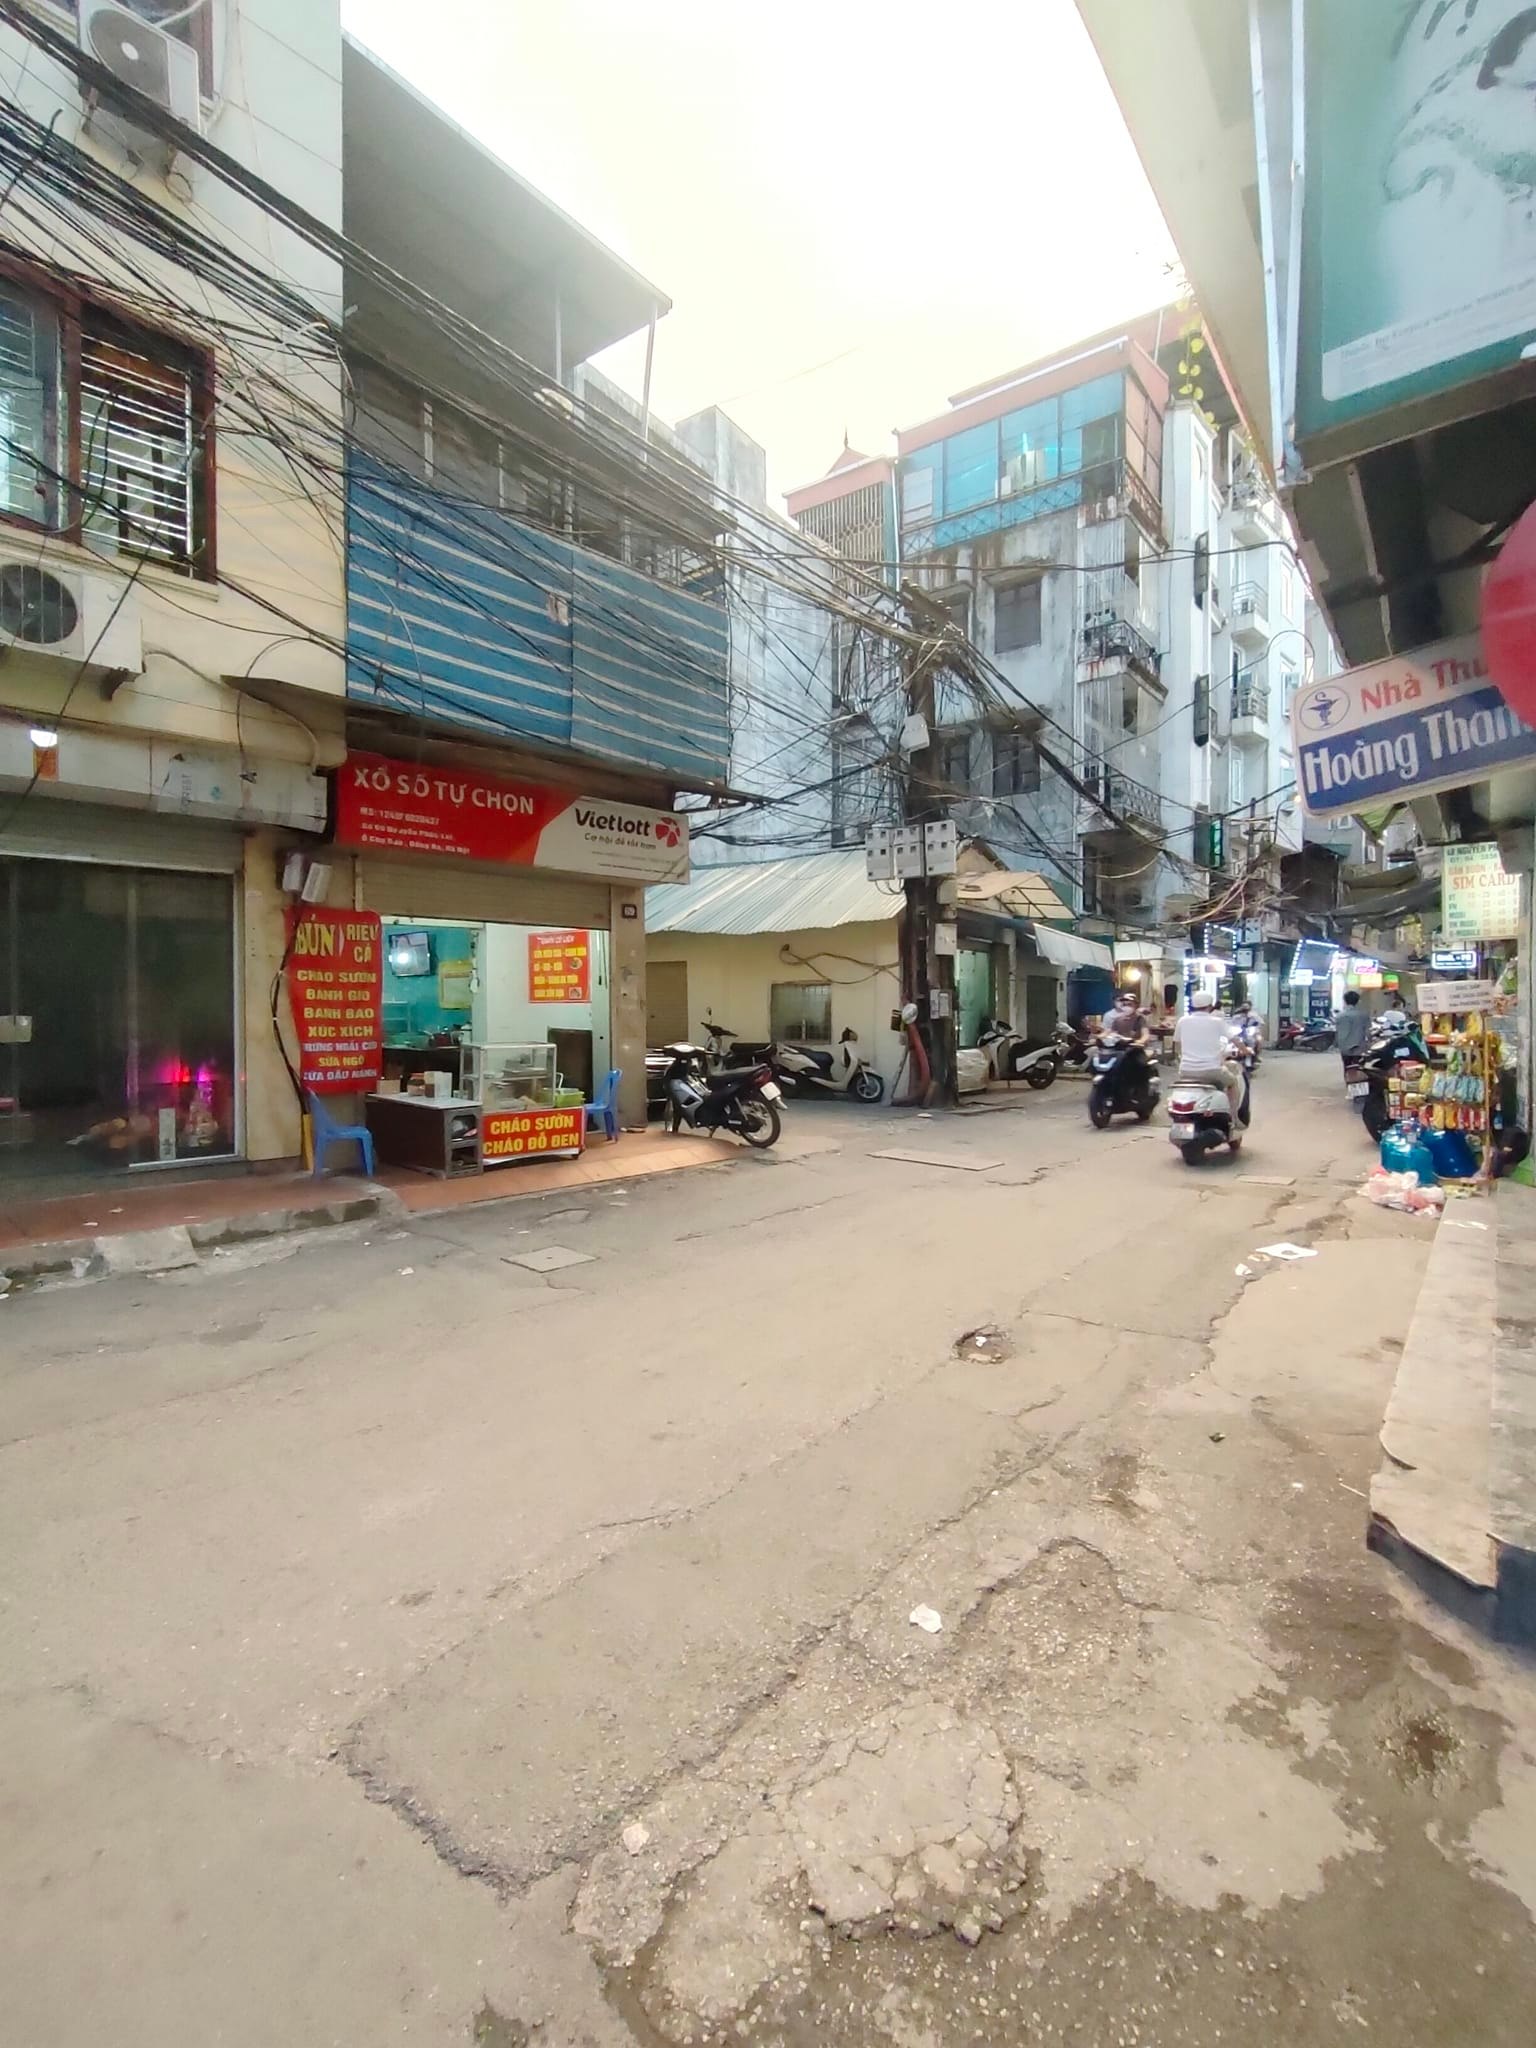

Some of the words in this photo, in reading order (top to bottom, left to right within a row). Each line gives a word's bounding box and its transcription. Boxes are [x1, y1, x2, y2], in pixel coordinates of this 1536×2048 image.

[1360, 672, 1422, 713] Nhà
[1430, 656, 1489, 691] Thu
[1303, 732, 1419, 794] Hoàng
[1421, 706, 1534, 760] Than
[354, 764, 391, 792] XỔ
[397, 772, 430, 798] SỐ
[434, 780, 467, 808] TỰ
[472, 787, 534, 816] CHỌN
[575, 807, 651, 837] Vietlott
[1453, 876, 1475, 890] SIM
[1479, 873, 1516, 888] CARD
[295, 913, 335, 957] BÚN
[490, 1117, 531, 1135] CHÁO
[535, 1113, 574, 1131] SƯỜN
[483, 1137, 523, 1155] CHÁO
[551, 1132, 579, 1148] ĐEN
